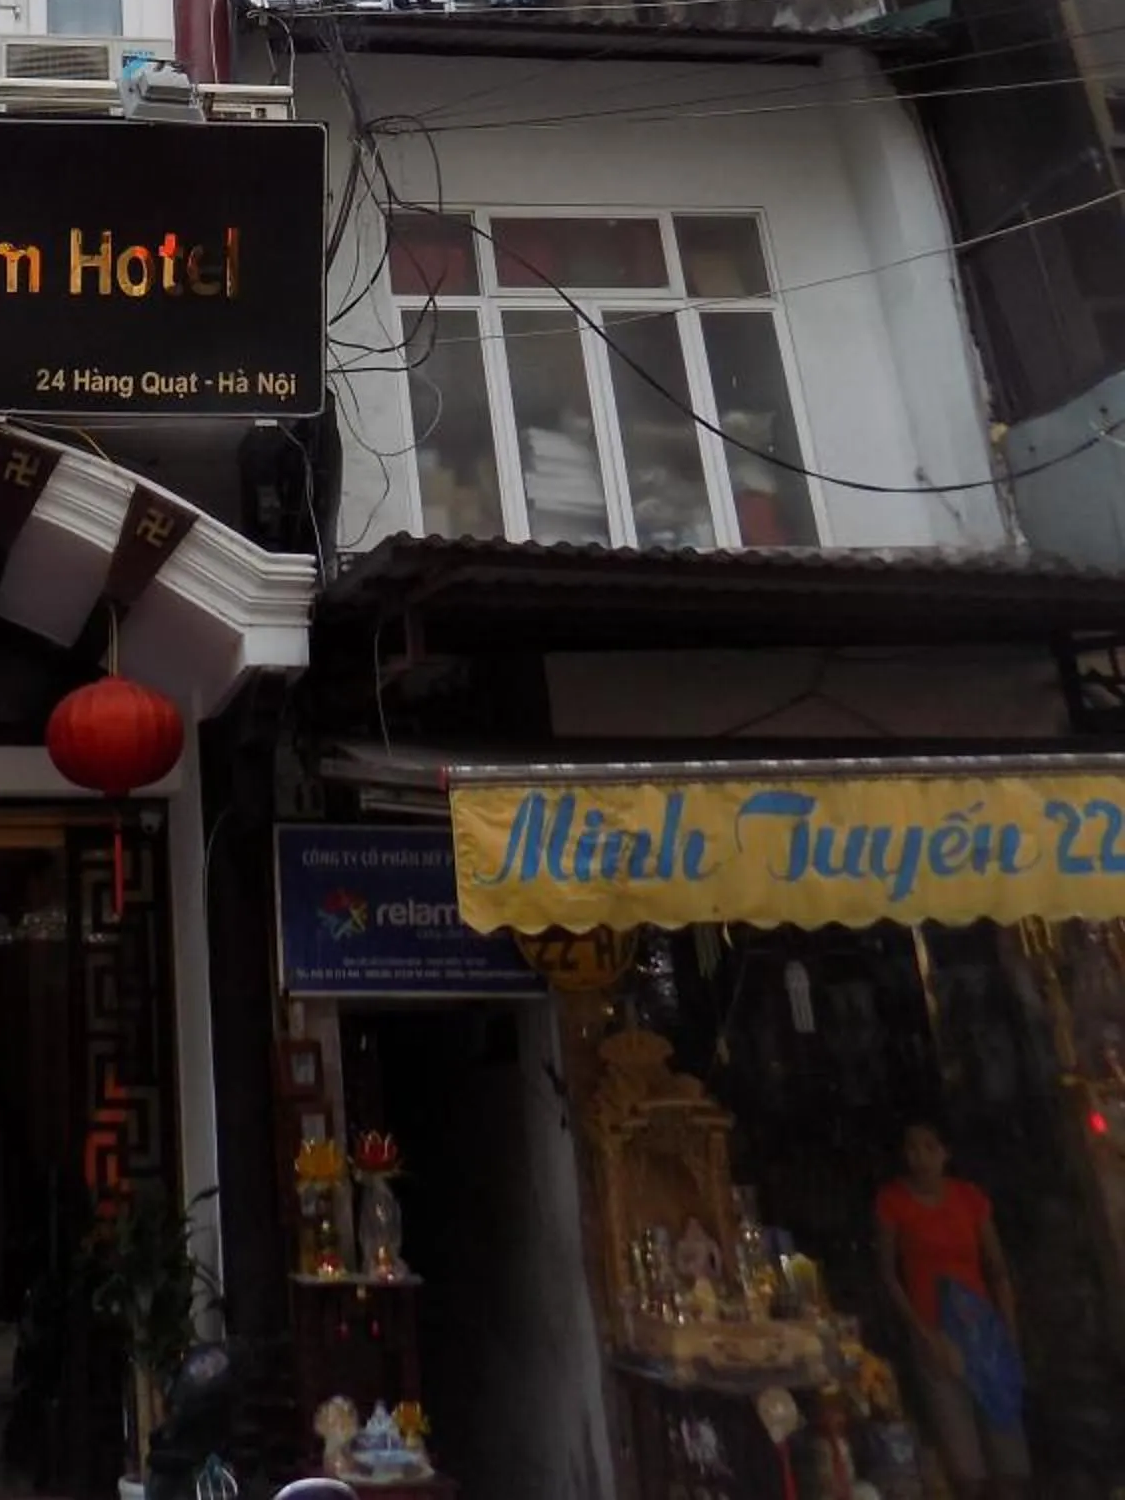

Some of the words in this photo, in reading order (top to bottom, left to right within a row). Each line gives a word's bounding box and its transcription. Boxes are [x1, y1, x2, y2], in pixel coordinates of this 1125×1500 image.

[68, 226, 239, 298] Hotel
[36, 368, 65, 391] 24
[74, 367, 133, 397] Hàng
[141, 371, 198, 399] Quạt
[218, 368, 249, 393] Hà
[257, 372, 296, 400] Nội
[473, 791, 723, 886] Minh
[733, 790, 1043, 902] Tuyến
